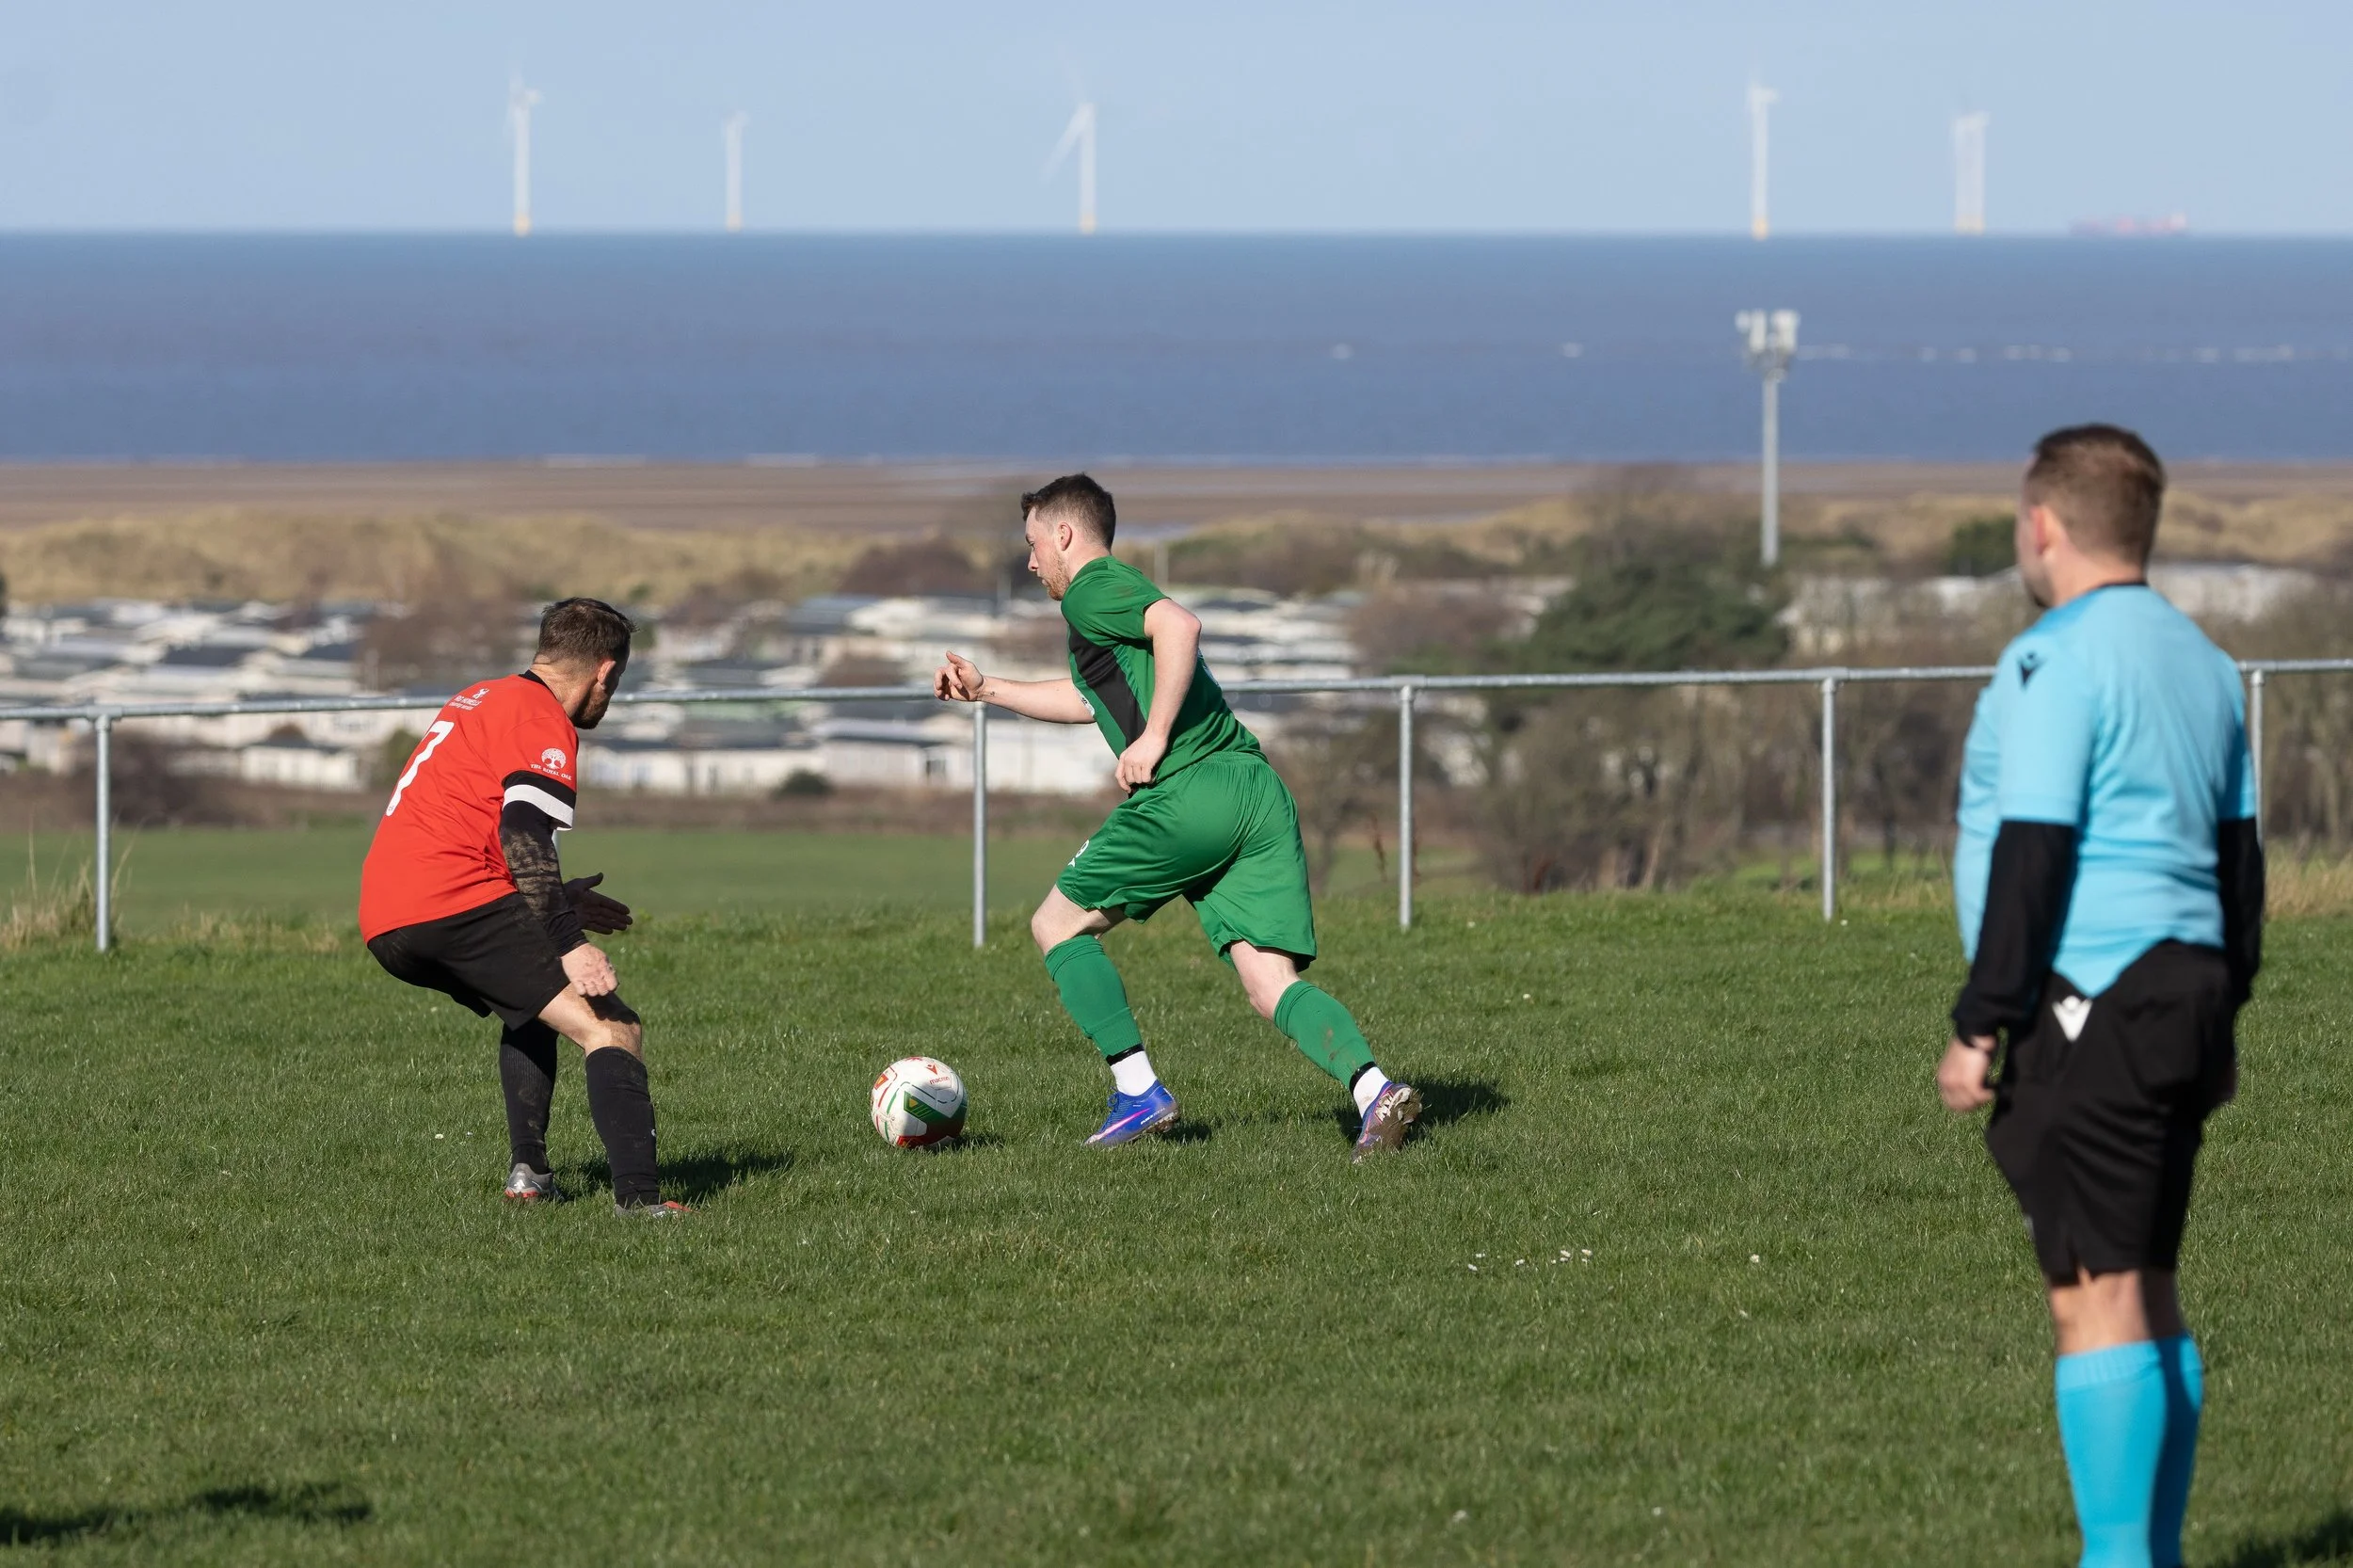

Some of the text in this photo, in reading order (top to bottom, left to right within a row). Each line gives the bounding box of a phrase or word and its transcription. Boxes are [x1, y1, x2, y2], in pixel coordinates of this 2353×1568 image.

[385, 721, 455, 817] 7
[542, 767, 560, 776] ROYAL
[561, 773, 572, 781] OAK
[929, 1076, 951, 1085] macron
